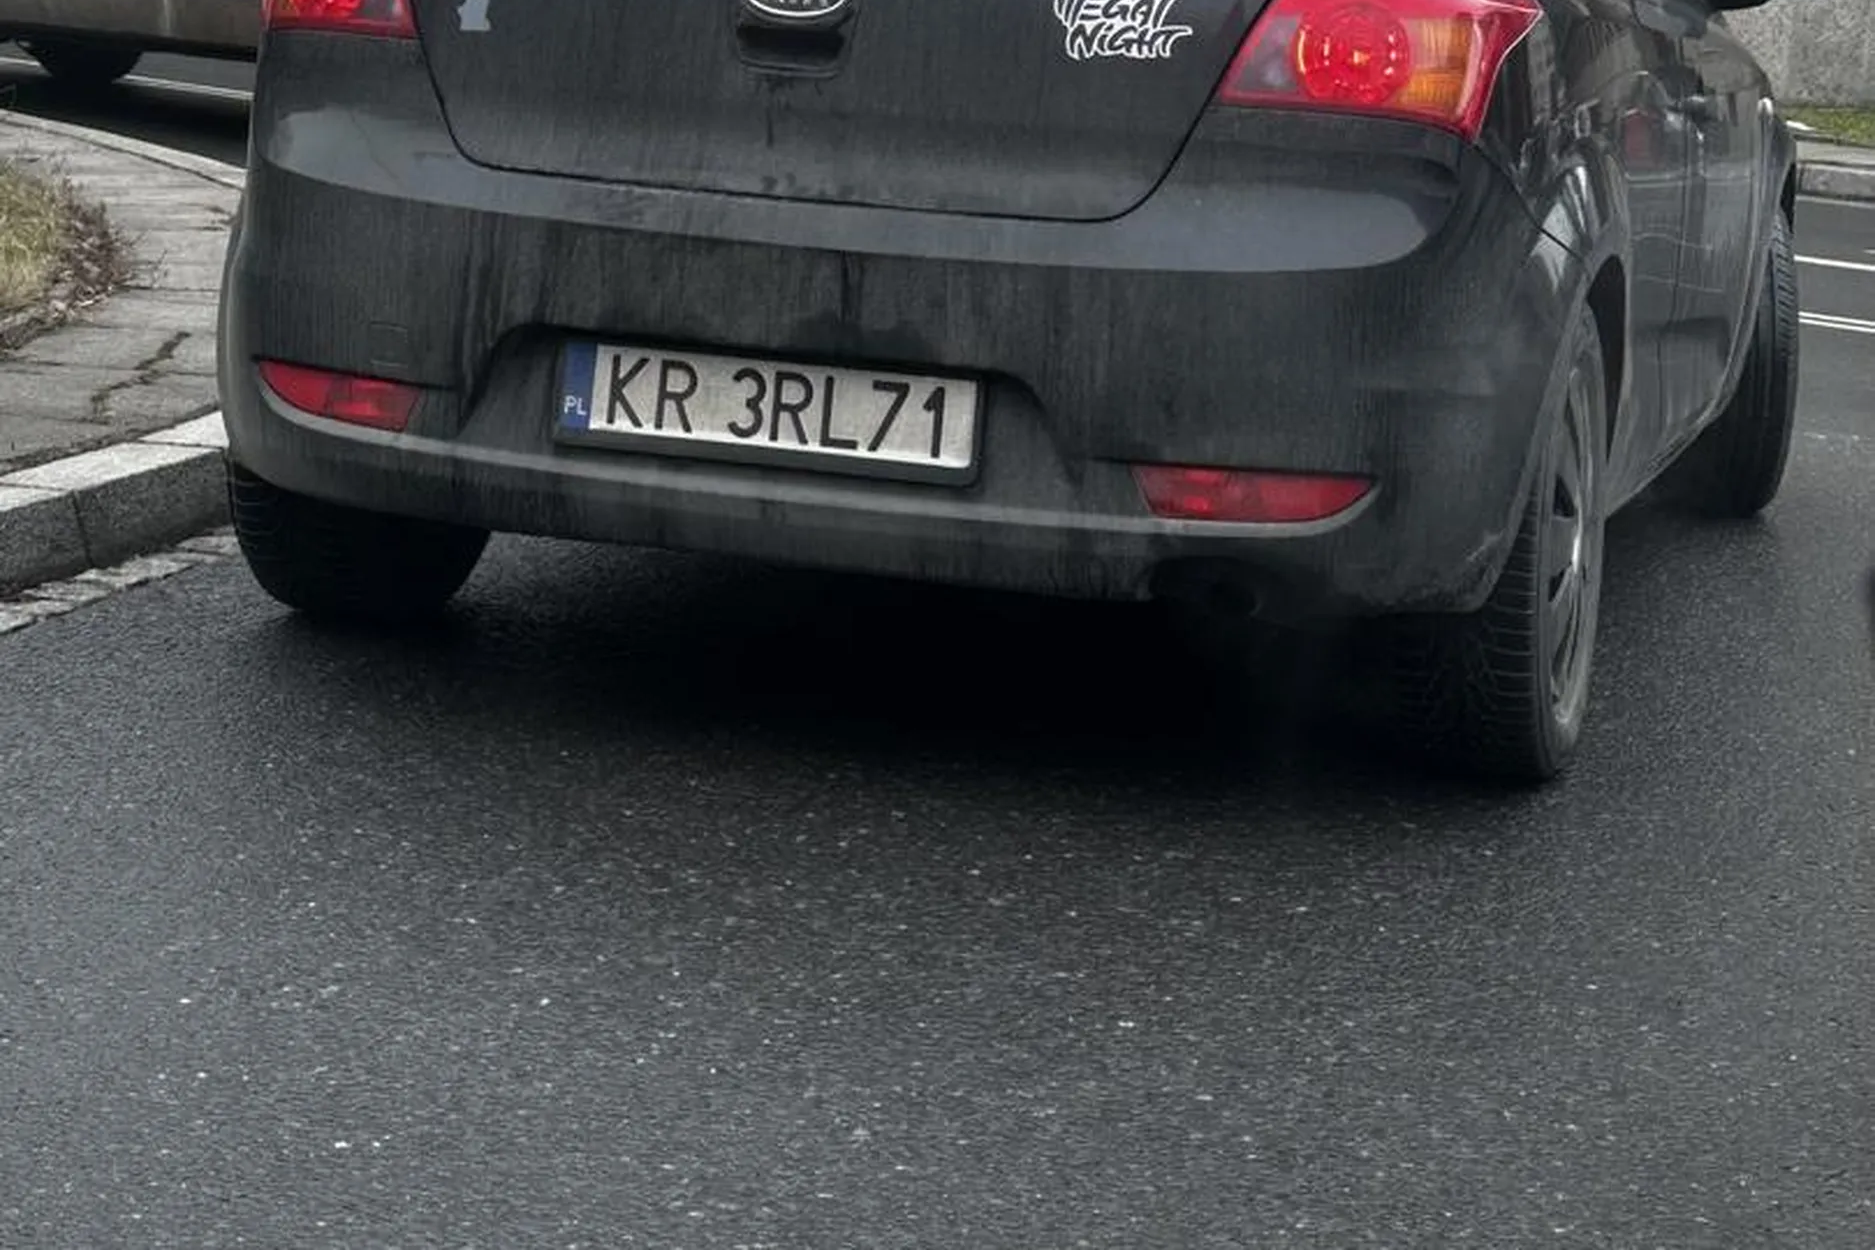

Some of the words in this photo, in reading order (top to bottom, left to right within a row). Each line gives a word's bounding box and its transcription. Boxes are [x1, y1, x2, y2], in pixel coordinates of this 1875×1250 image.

[563, 395, 587, 417] PL
[606, 353, 698, 434] KR
[727, 367, 947, 459] 3RL71
